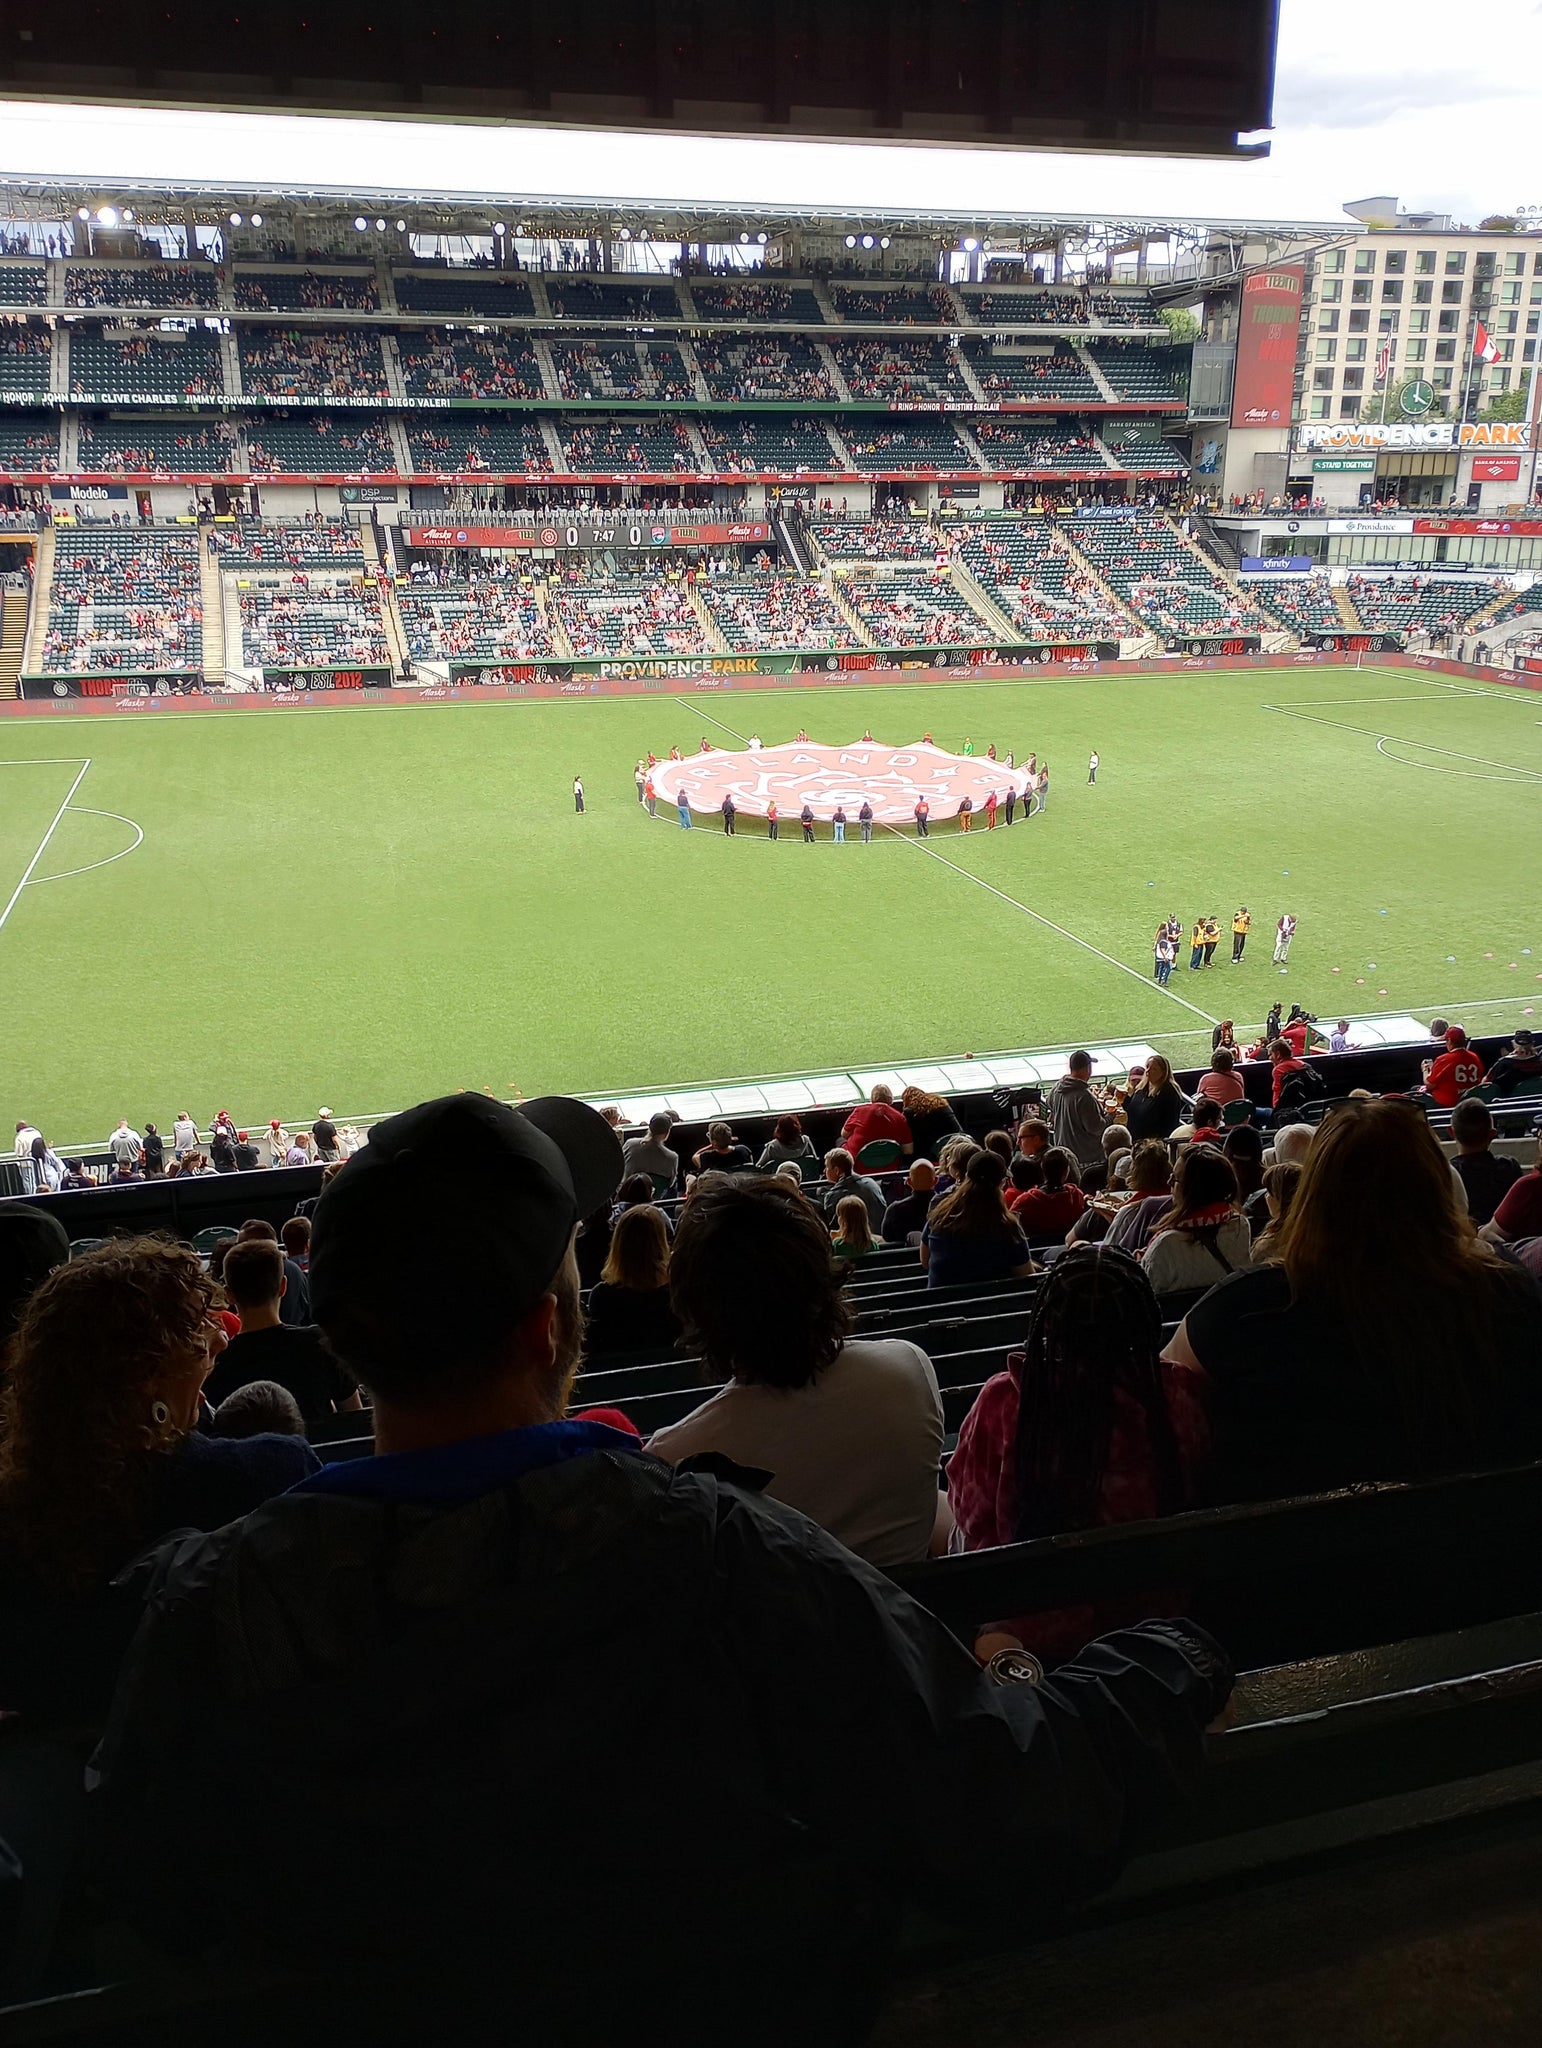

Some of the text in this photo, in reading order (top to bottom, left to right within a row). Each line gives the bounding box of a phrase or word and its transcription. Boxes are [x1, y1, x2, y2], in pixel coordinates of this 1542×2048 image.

[1252, 305, 1297, 324] THORNS
[2, 392, 450, 408] HONOR JOHN BAIN CLIVE CHARLES JIMMY CONWAY TIMBER JIM MICK HOBAN DIEGO VALERI
[897, 402, 914, 411] RING
[918, 402, 940, 411] HONOR
[943, 402, 973, 411] CHRISTINE
[973, 402, 1000, 411] SINCLAIR
[1300, 421, 1527, 447] PROVIDENCE PARK
[1321, 460, 1373, 469] STAND TOGETHER
[70, 485, 108, 499] Modelo
[361, 488, 380, 497] DSP
[1114, 508, 1123, 516] FOR
[1356, 522, 1396, 532] Providence
[422, 528, 452, 540] Alaska
[565, 526, 641, 546] 0 7:47 0
[1262, 559, 1290, 570] xfinity
[1222, 639, 1244, 655] 2012
[1369, 637, 1383, 650] FC
[1050, 646, 1087, 662] THORNS
[600, 658, 759, 677] PROVIDENCE PARK
[838, 655, 875, 670] THORNS
[310, 672, 363, 689] EST. 2012
[695, 678, 720, 686] Alaska
[419, 688, 446, 696] Alaska
[560, 683, 586, 691] Alaska
[115, 698, 145, 707] Alaska
[272, 693, 300, 702] Alaska
[1455, 1064, 1478, 1082] 63
